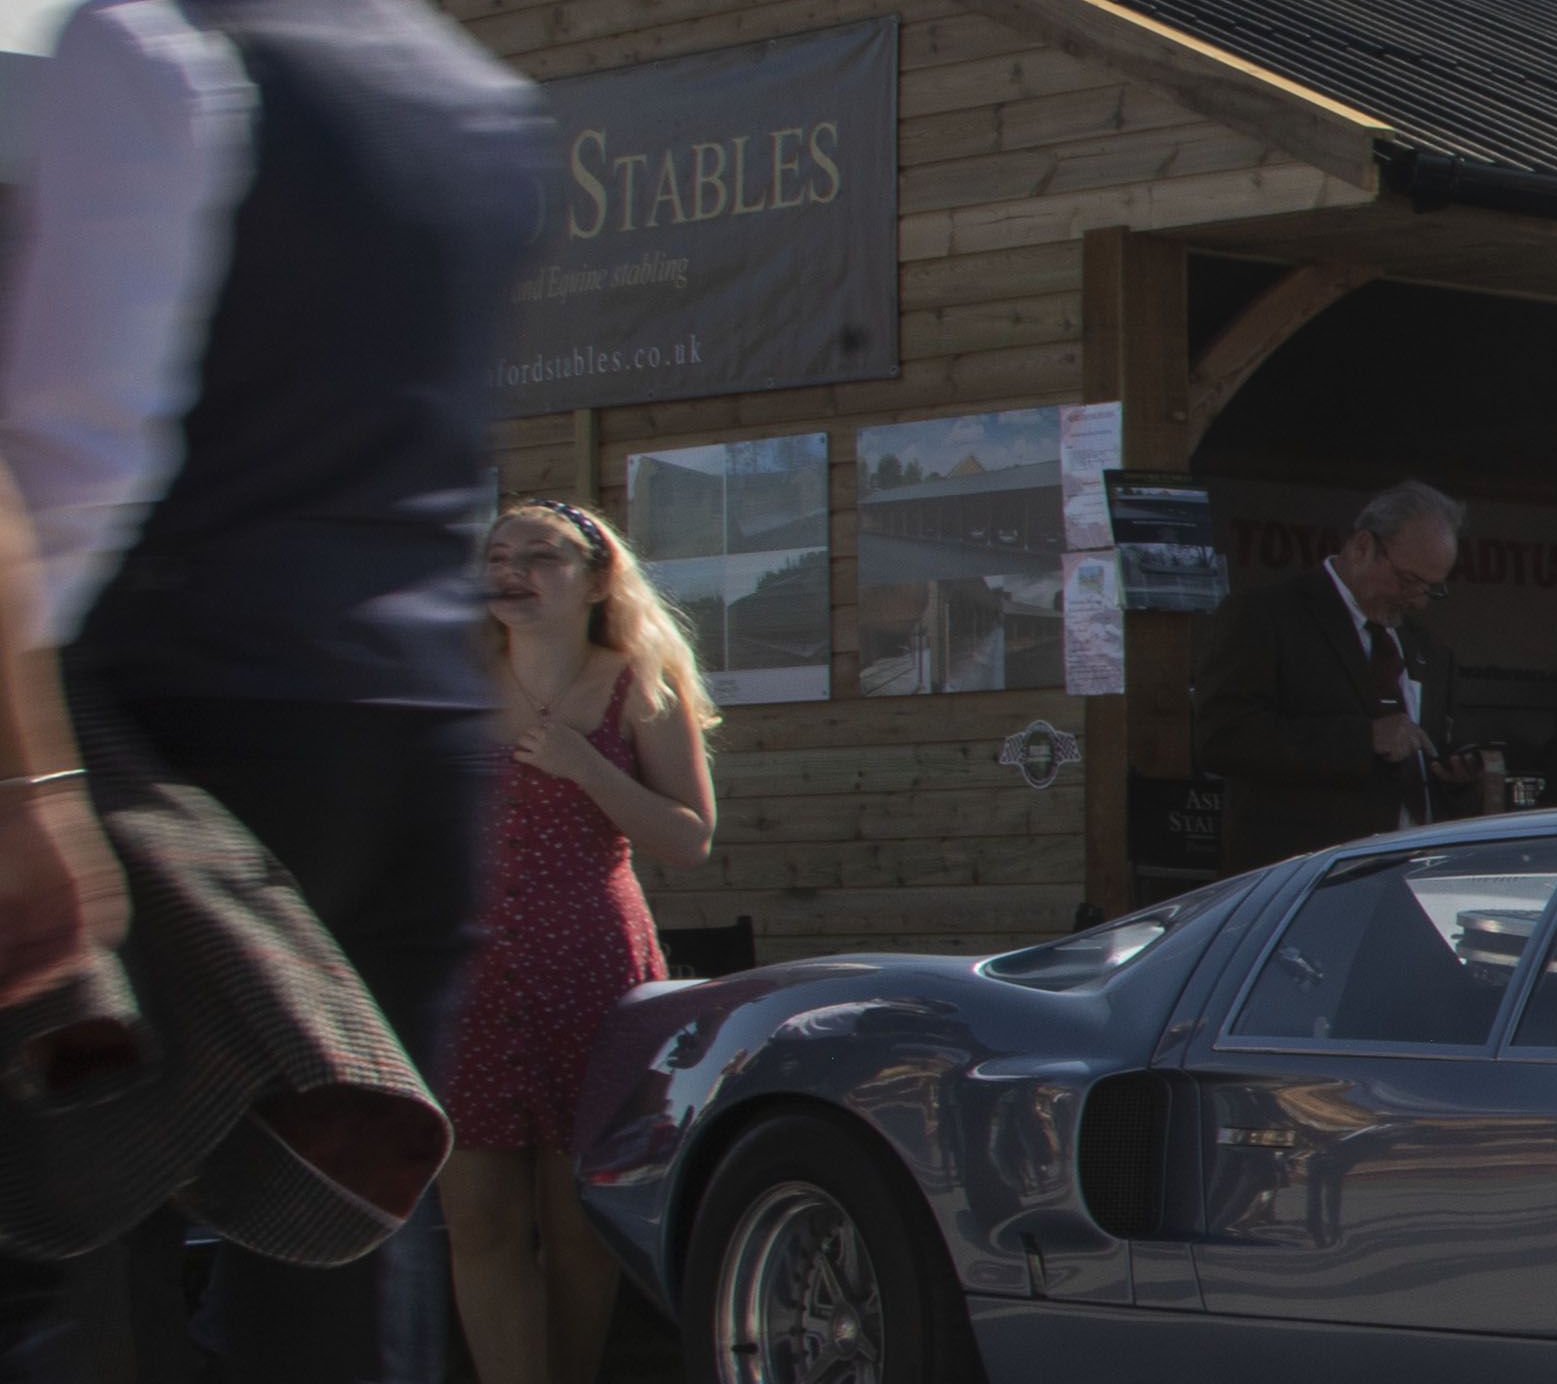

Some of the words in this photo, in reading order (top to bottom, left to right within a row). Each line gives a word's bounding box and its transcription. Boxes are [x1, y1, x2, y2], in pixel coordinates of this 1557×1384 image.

[568, 120, 842, 241] STABLES
[610, 249, 690, 289] stabling
[489, 334, 703, 388] fordstables.co.uk
[1231, 519, 1342, 568] TOTA
